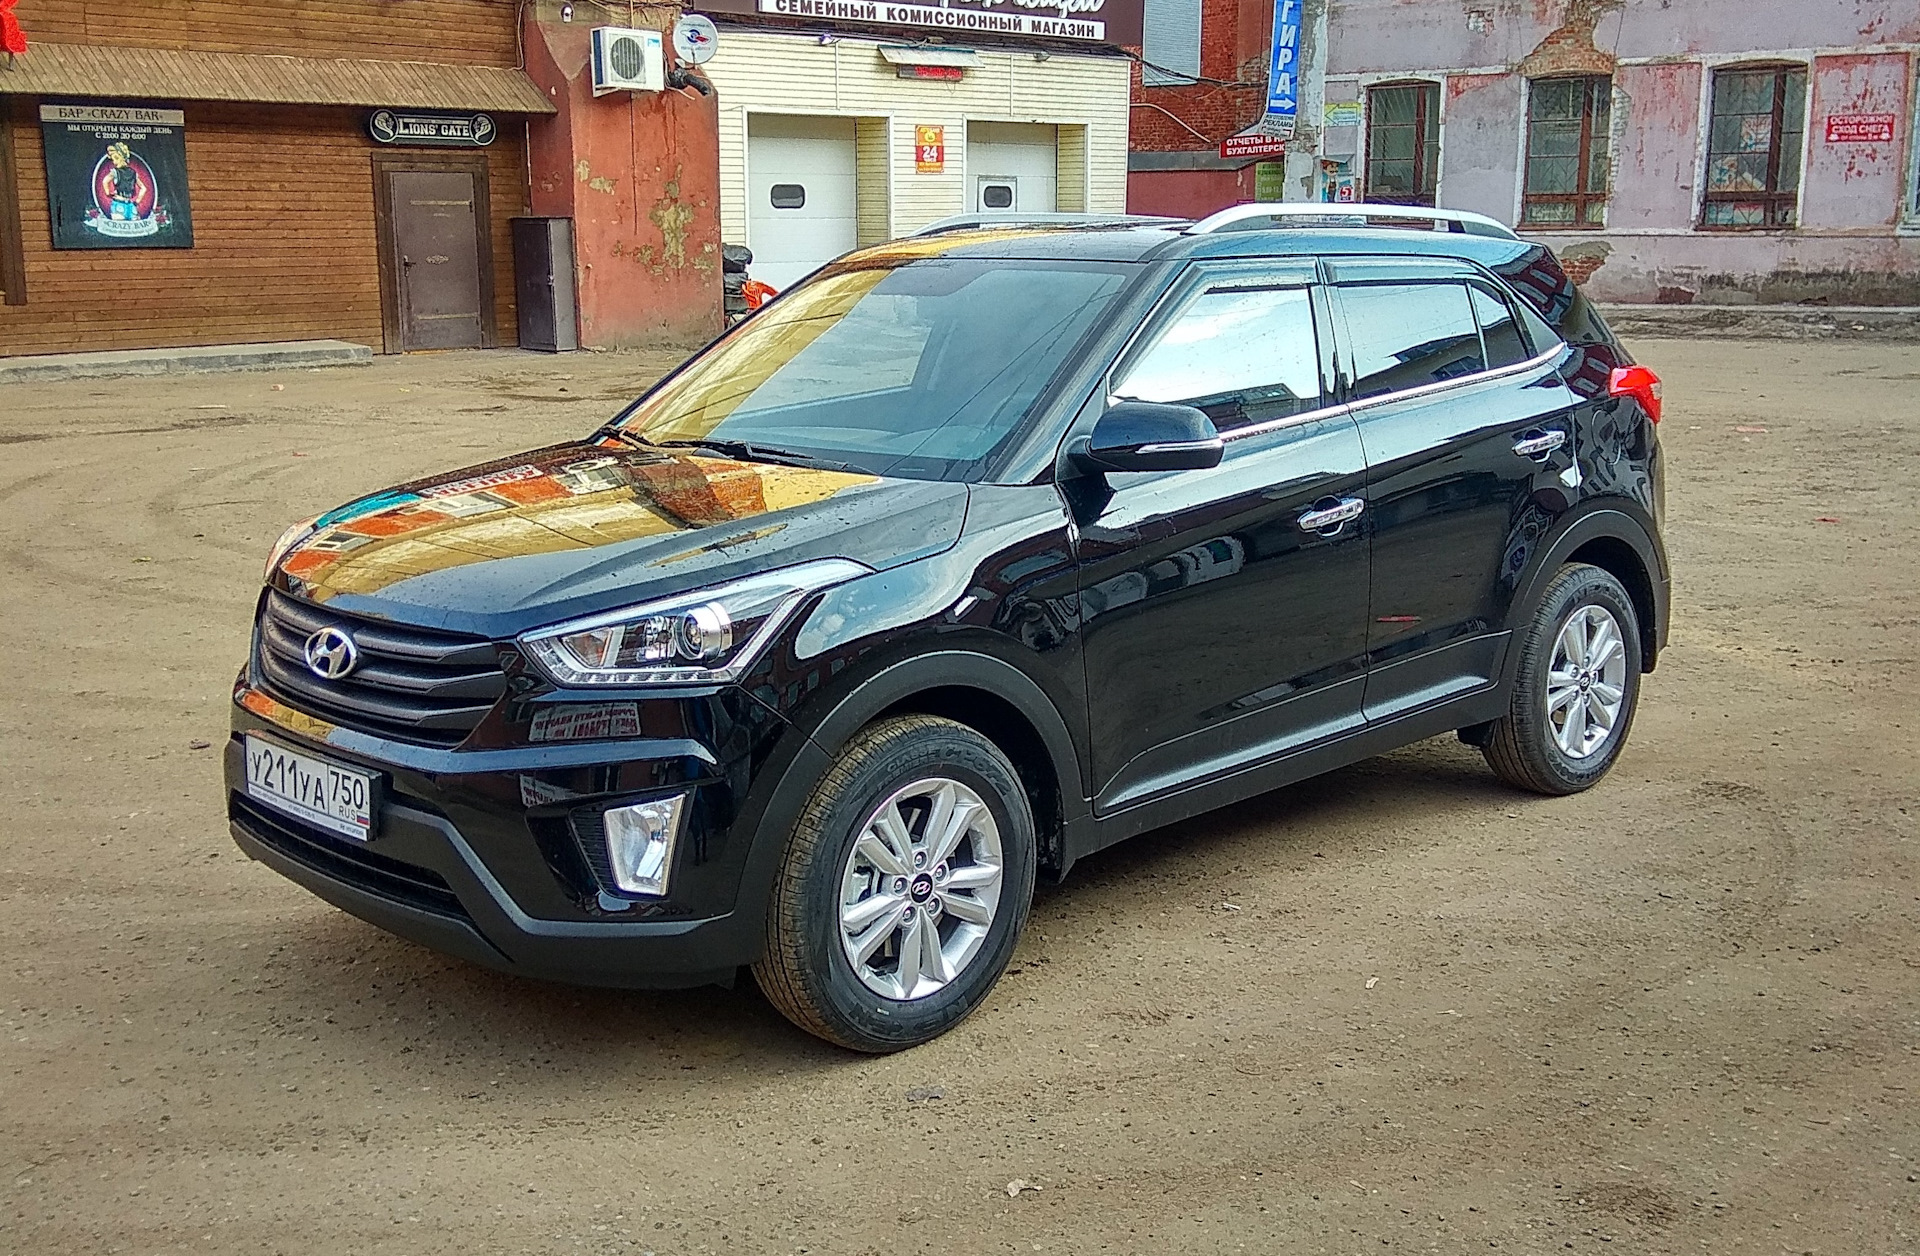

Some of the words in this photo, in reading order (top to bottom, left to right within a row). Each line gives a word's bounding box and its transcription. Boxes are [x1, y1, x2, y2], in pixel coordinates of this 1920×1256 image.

[776, 0, 877, 20] СЕМЕЙНЫЙ
[886, 6, 1023, 32] КОМИССИОННЫЙ
[1031, 20, 1095, 38] МАГАЗИН
[58, 107, 84, 118] БАР
[67, 124, 80, 132] МЫ
[81, 125, 118, 133] ОТКРЫТЫ
[153, 127, 173, 135] ДЕНЬ
[441, 124, 470, 136] GATE
[1858, 124, 1890, 134] СНЕГА
[1226, 136, 1263, 147] ОТЧЕТЫ
[922, 145, 939, 163] 24
[330, 769, 364, 810] 750
[338, 806, 356, 821] RUS
